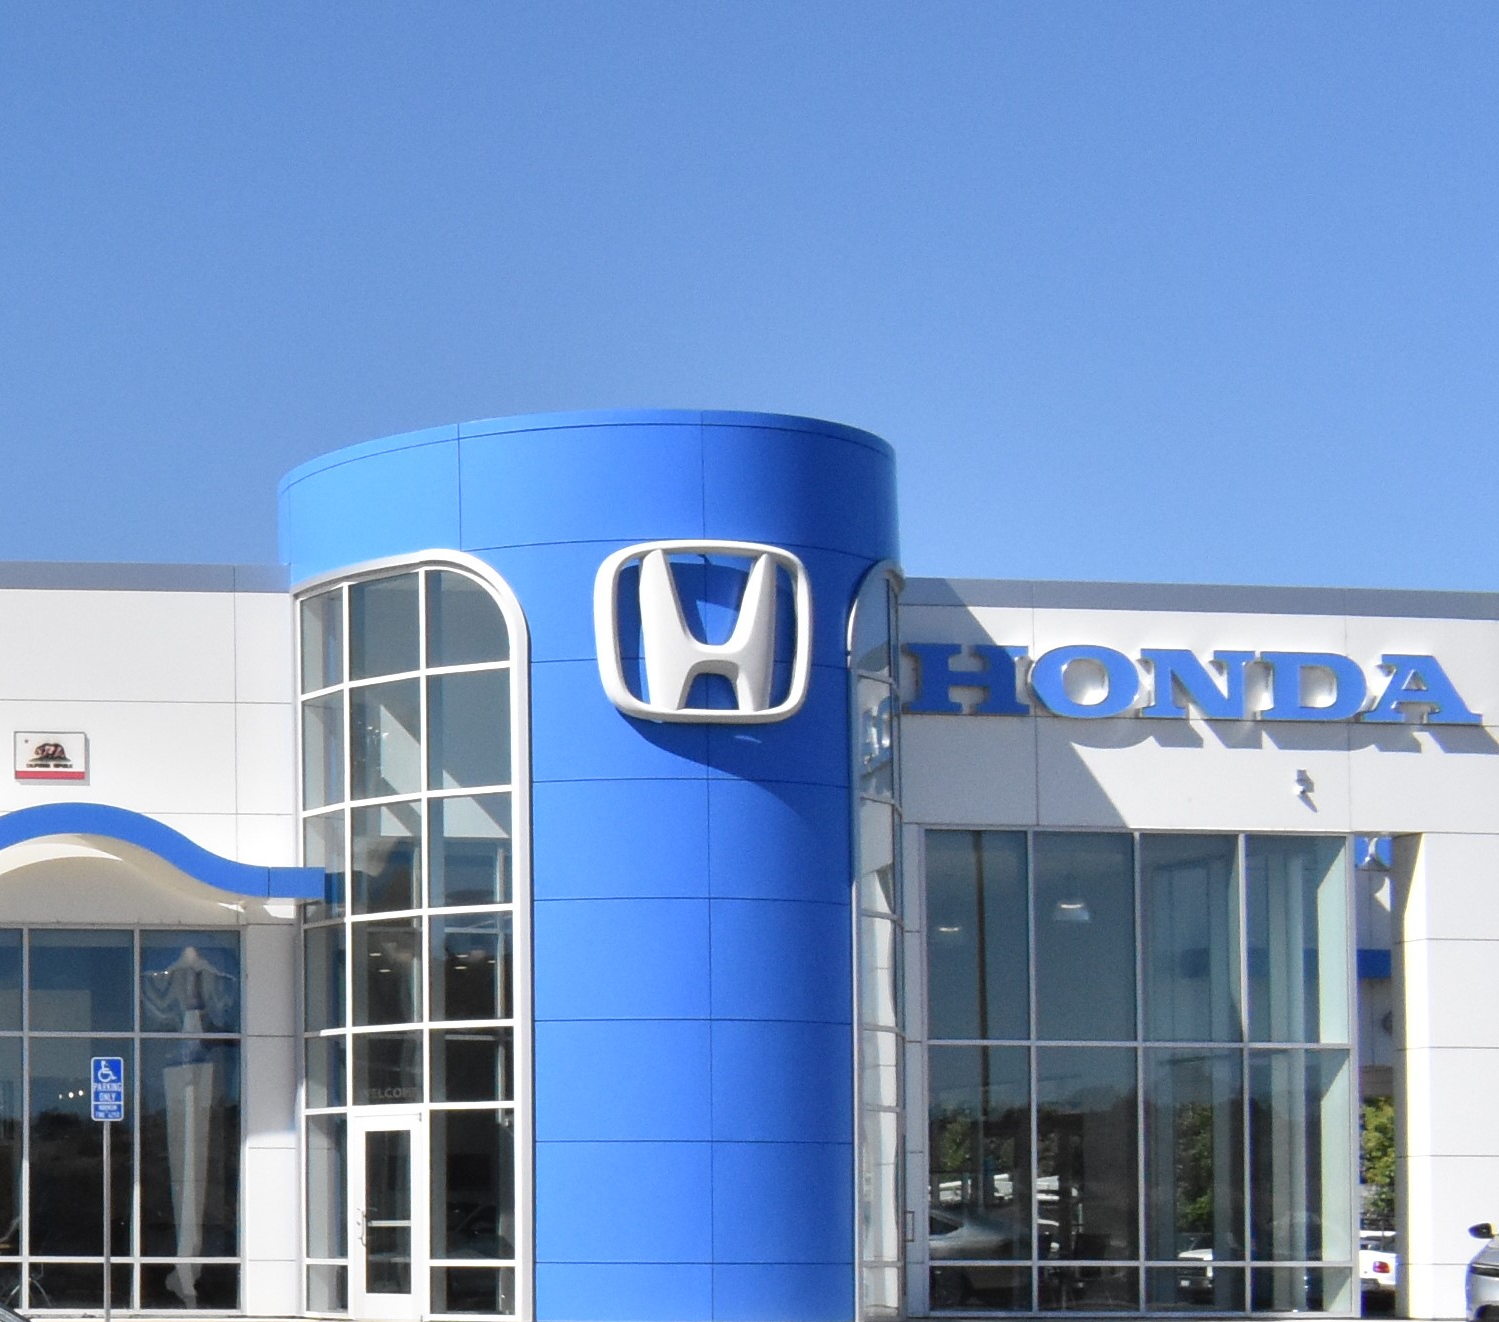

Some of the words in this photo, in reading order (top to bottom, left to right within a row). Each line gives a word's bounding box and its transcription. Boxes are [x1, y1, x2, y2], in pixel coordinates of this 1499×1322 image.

[906, 642, 1483, 725] HONDA
[93, 1082, 122, 1092] PARKING
[98, 1092, 116, 1102] ONLY
